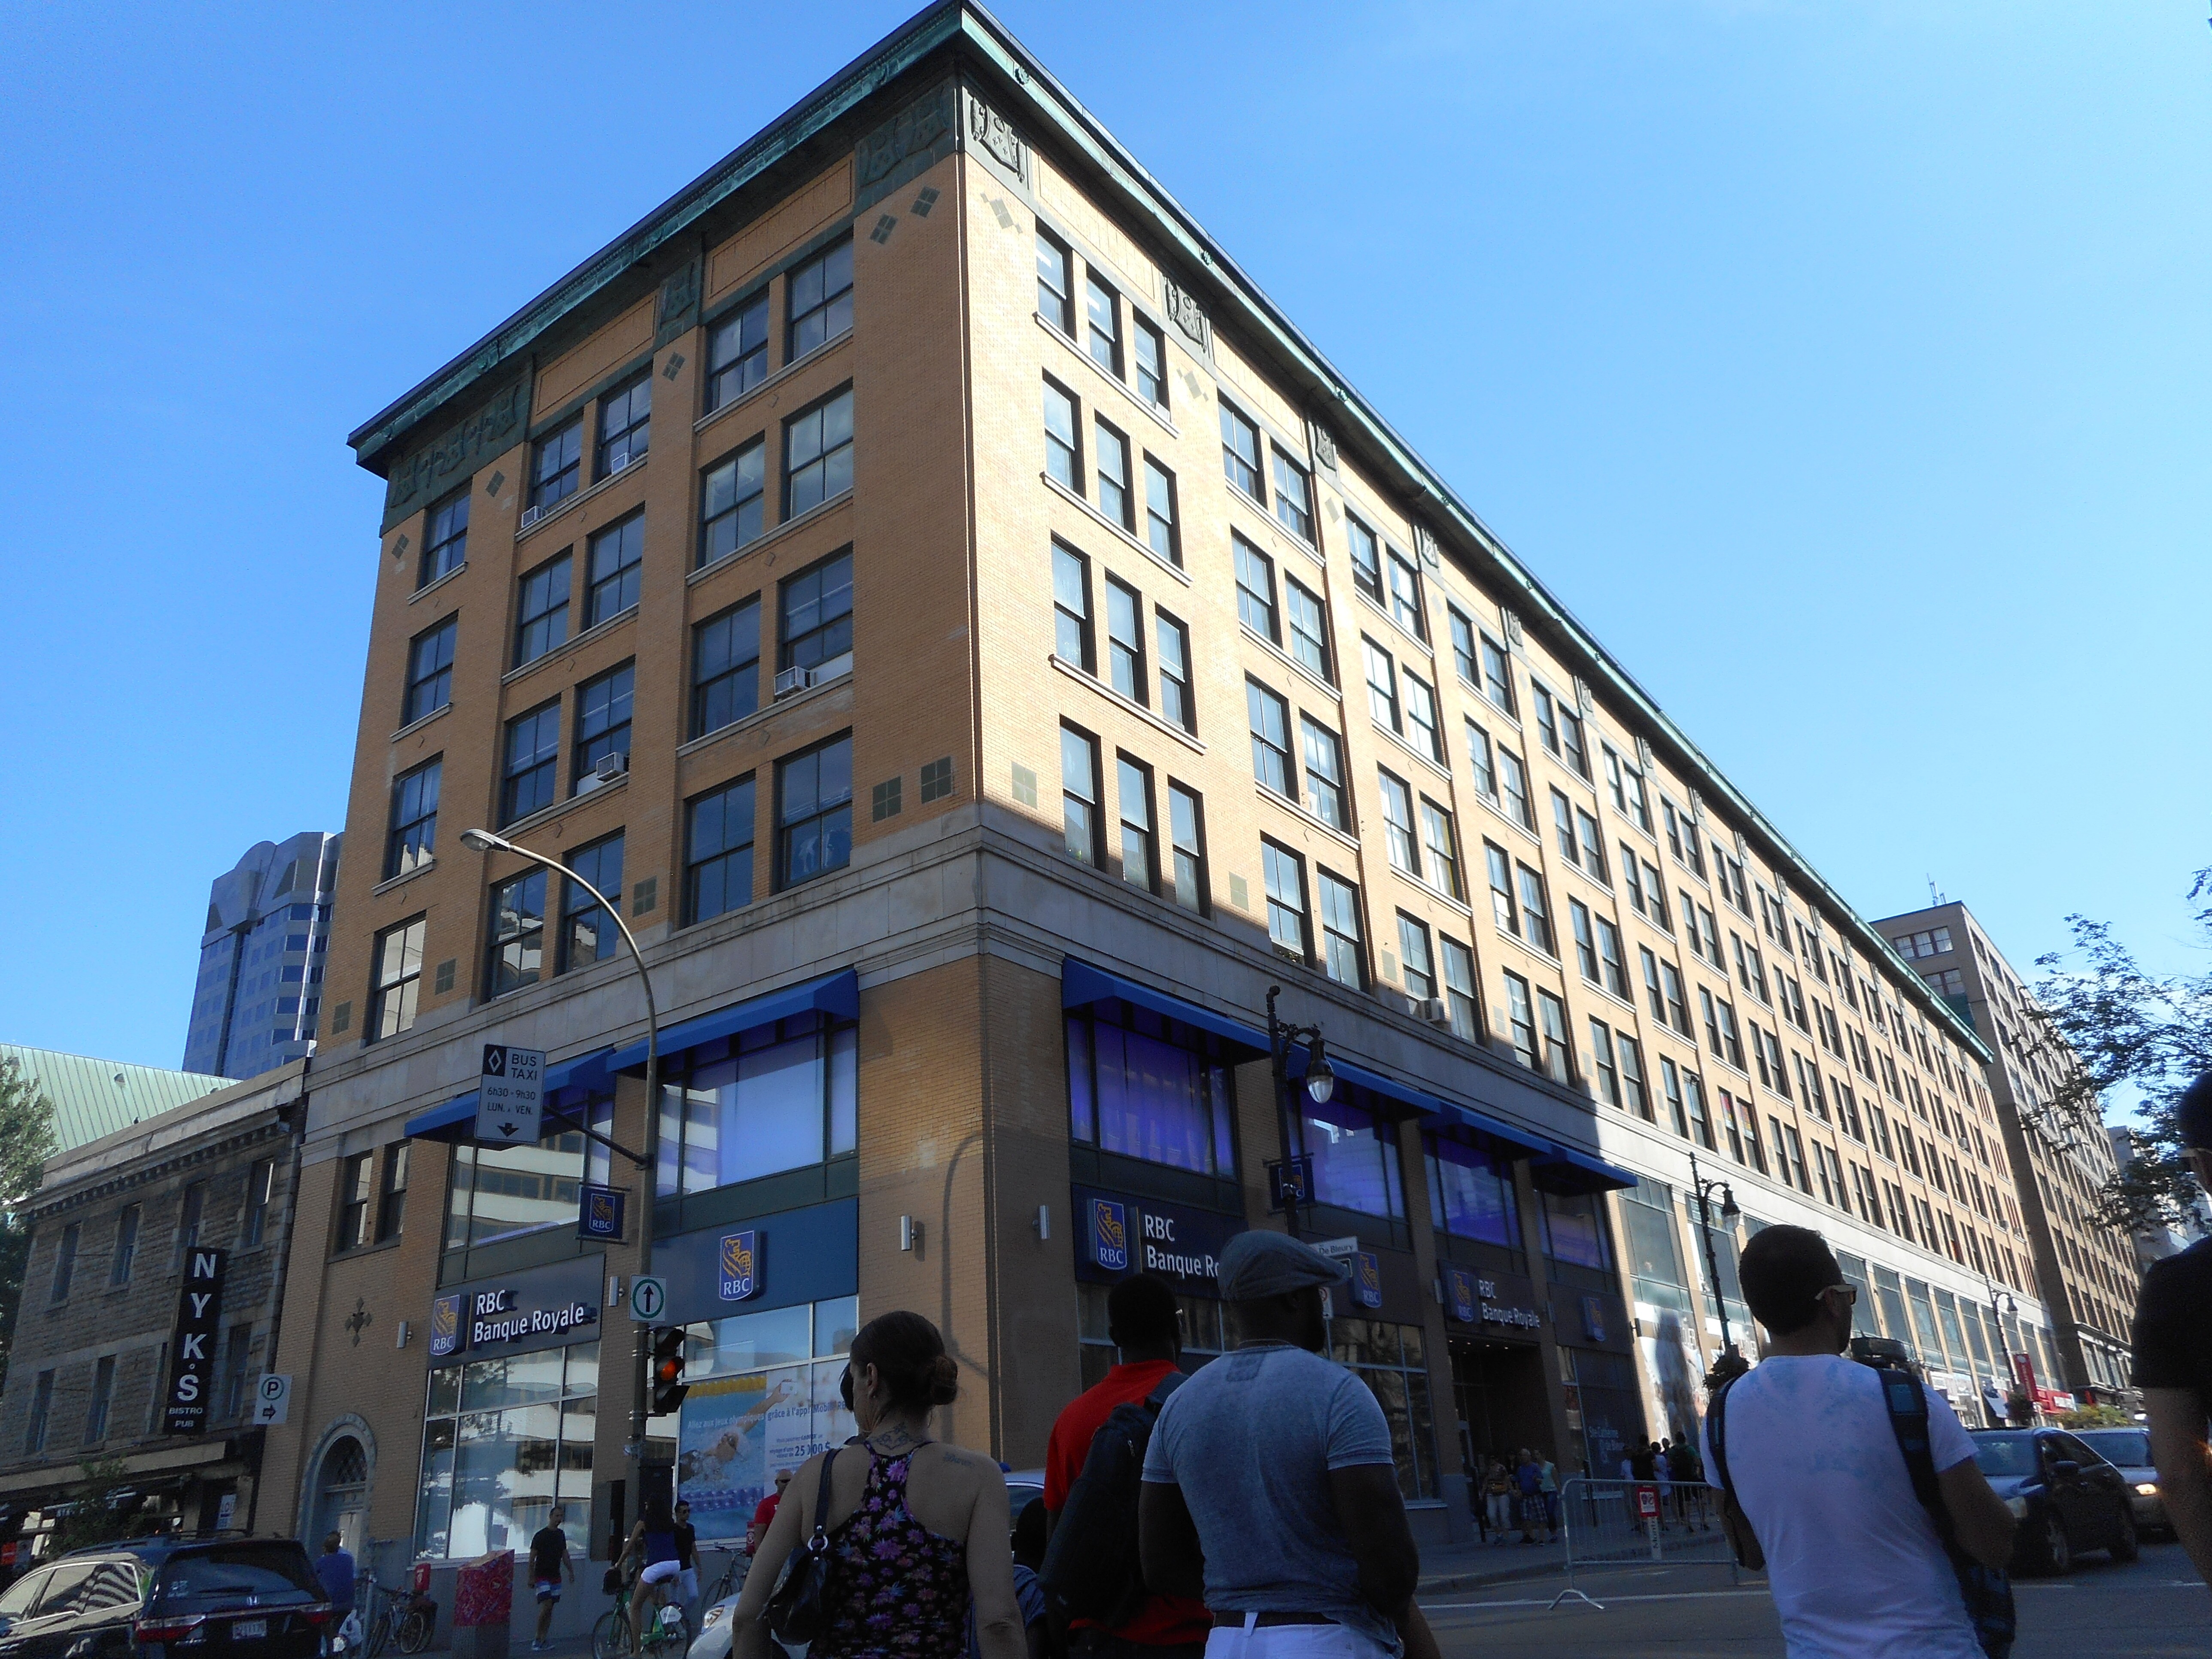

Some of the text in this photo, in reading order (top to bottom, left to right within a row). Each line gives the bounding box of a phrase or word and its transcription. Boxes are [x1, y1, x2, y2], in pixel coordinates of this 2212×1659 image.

[511, 1054, 536, 1066] BUS
[511, 1067, 537, 1081] TAXI
[487, 1087, 508, 1097] 6h30
[516, 1090, 536, 1100] 9h30
[487, 1102, 505, 1112] LUN.
[592, 1220, 611, 1229] RBC
[1145, 1214, 1175, 1242] RBC
[1100, 1247, 1124, 1264] RBC
[1147, 1245, 1202, 1279] Banque
[723, 1278, 749, 1295] RBC
[1478, 1279, 1497, 1299] RBC
[476, 1289, 506, 1316] RBC
[1363, 1290, 1379, 1303] RBC
[474, 1302, 584, 1343] Banque Royale
[1481, 1302, 1540, 1330] Banque Royale
[433, 1336, 453, 1351] RBC
[267, 1381, 279, 1395] P
[768, 1409, 785, 1421] grâce
[795, 1445, 805, 1456] 25
